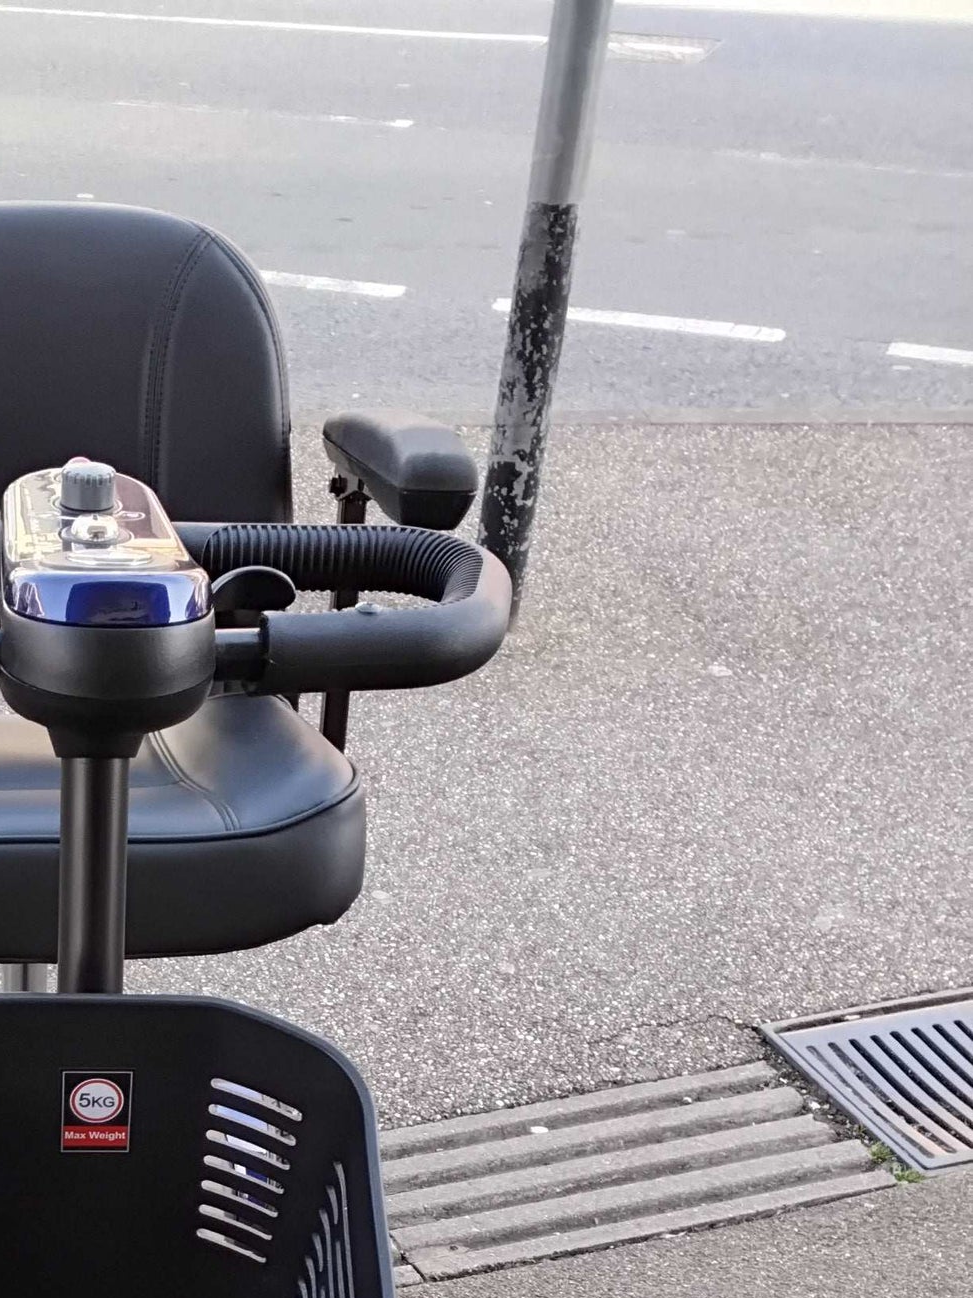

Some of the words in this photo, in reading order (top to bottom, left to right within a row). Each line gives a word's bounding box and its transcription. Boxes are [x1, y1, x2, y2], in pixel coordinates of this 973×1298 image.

[78, 1093, 115, 1108] 5KG
[64, 1131, 86, 1140] Max
[89, 1131, 126, 1141] Weight
